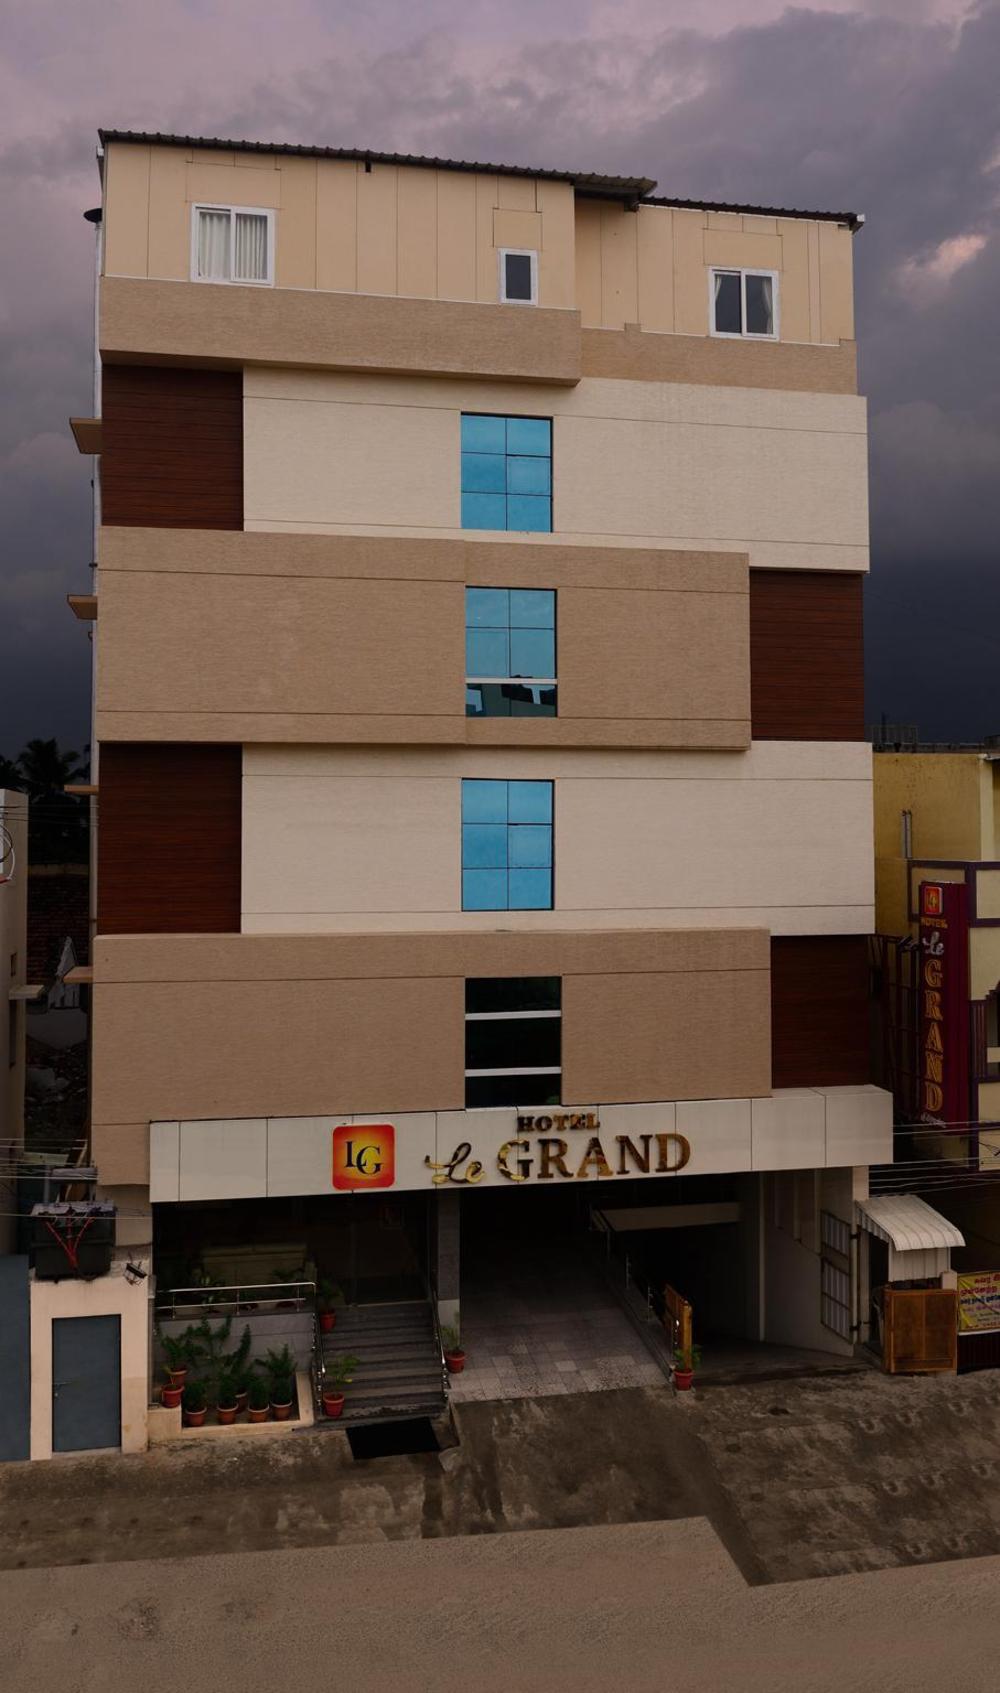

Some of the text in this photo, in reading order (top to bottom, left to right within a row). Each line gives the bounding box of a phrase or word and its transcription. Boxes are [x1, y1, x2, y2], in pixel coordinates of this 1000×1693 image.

[922, 931, 945, 955] Le
[924, 959, 944, 1111] GRAND
[516, 1112, 600, 1133] HOTEL
[344, 1141, 384, 1175] LG
[424, 1133, 691, 1184] Le GRAND
